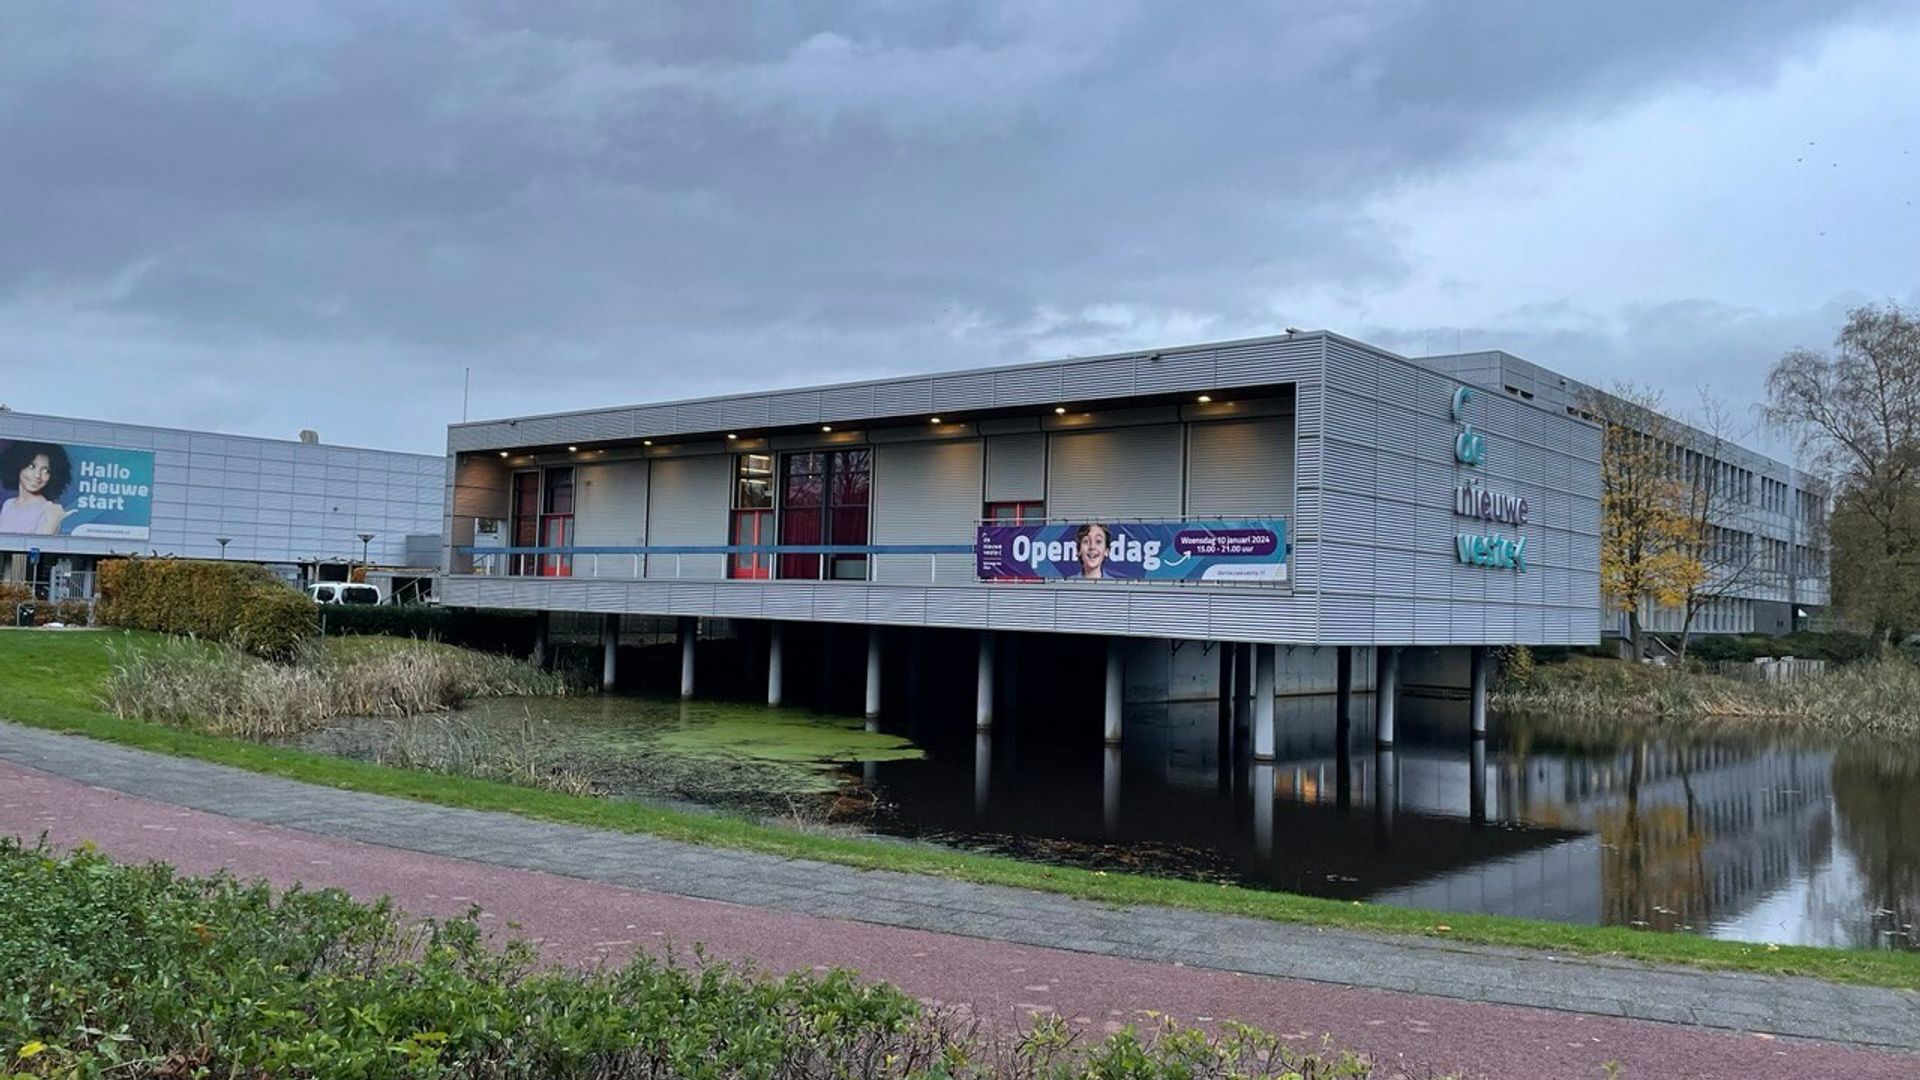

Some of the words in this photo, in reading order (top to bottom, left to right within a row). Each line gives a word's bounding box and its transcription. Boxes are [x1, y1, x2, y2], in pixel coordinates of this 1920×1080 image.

[1456, 424, 1486, 466] de
[80, 461, 130, 480] Hallo
[79, 478, 148, 497] nieuwe
[78, 495, 124, 511] start
[1456, 479, 1528, 526] nieuwe
[1181, 536, 1216, 546] Woensdag
[1226, 536, 1250, 545] januari
[1251, 535, 1270, 544] 2024
[1221, 545, 1241, 553] 21.00
[1013, 535, 1078, 569] Open
[1110, 534, 1162, 571] dag
